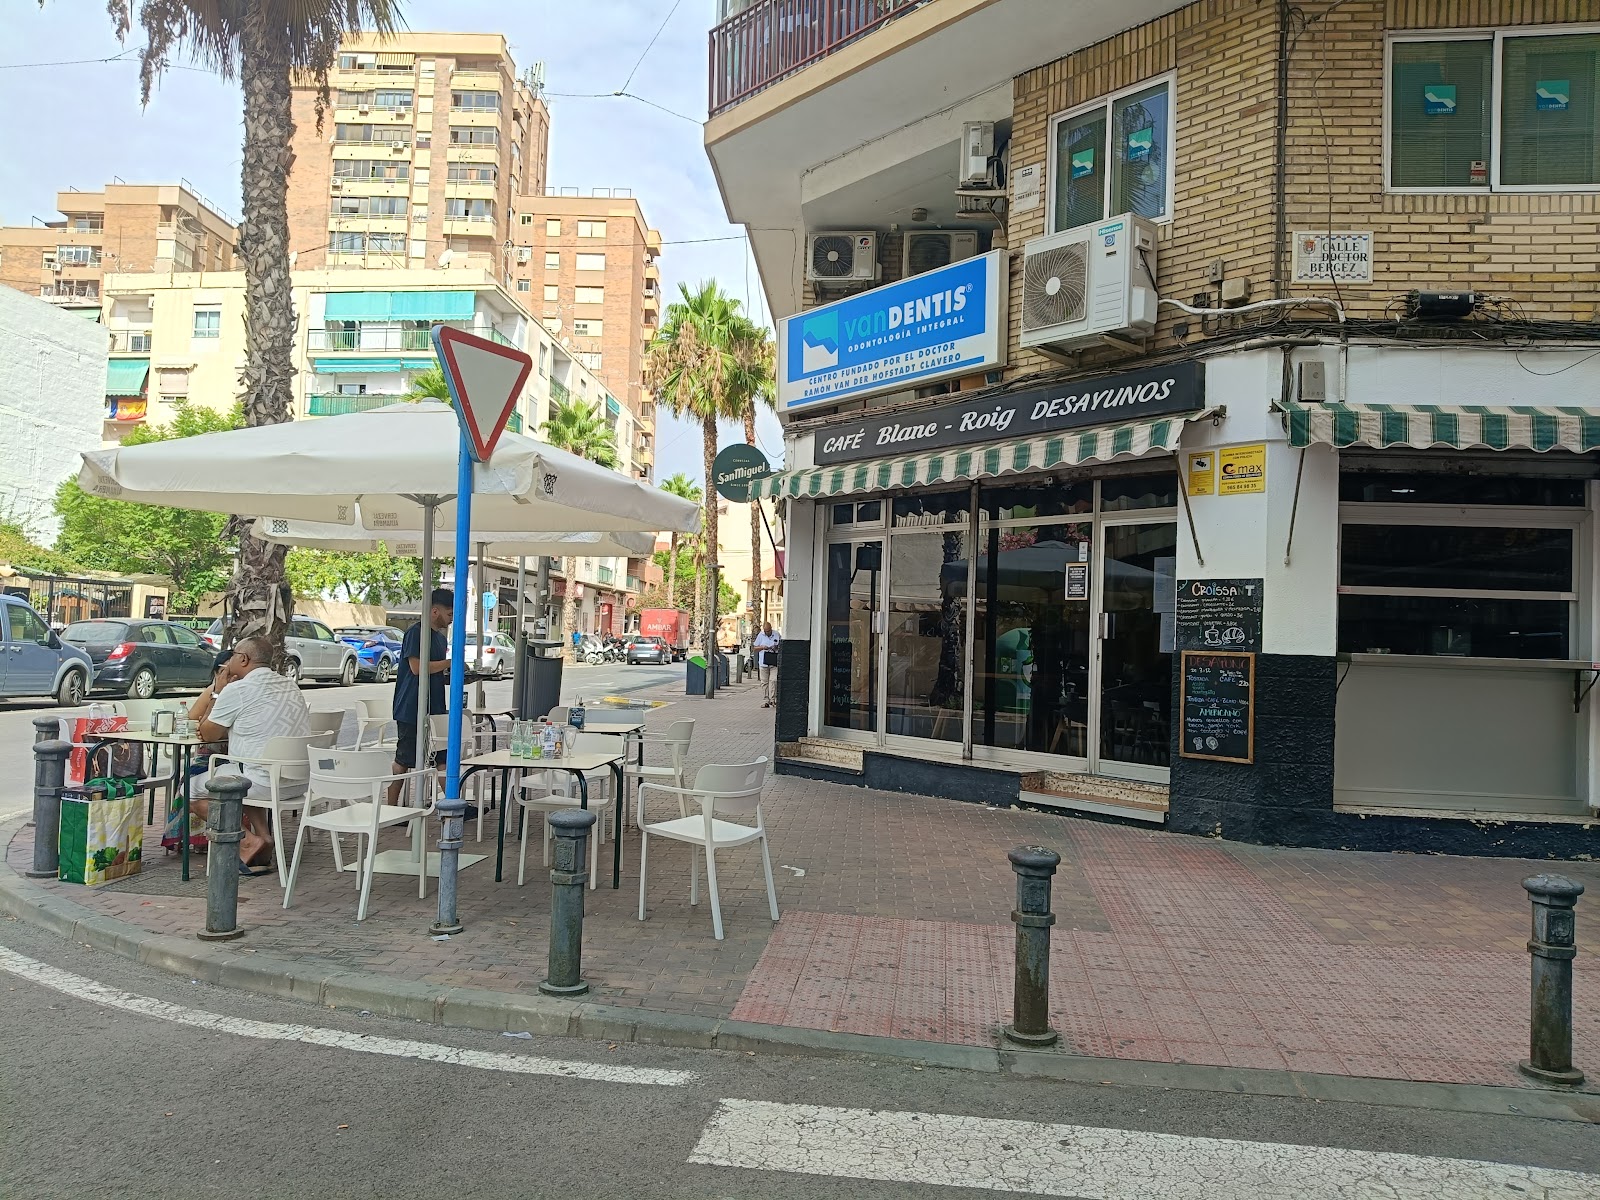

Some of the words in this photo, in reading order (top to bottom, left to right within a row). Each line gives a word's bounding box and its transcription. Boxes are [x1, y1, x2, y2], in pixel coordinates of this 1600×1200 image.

[1321, 252, 1368, 262] DOCTOR
[1322, 242, 1360, 252] CALLE
[1310, 262, 1356, 273] BERGEZ
[847, 328, 912, 354] ODONTOLOGÍA
[916, 316, 965, 336] INTEGRAL
[808, 371, 838, 386] CENTRO
[840, 361, 880, 378] FUNDADO
[883, 355, 901, 369] POR
[903, 352, 915, 364] EL
[917, 342, 956, 359] DOCTOR
[833, 378, 851, 391] VAN
[853, 374, 869, 387] DER
[871, 362, 917, 382] HOFSTADT
[919, 352, 962, 372] CLAVERO
[822, 430, 866, 454] CAFÉ
[875, 421, 938, 446] Blanc
[958, 405, 1017, 432] Roig
[1030, 378, 1176, 421] DESAYUNOS
